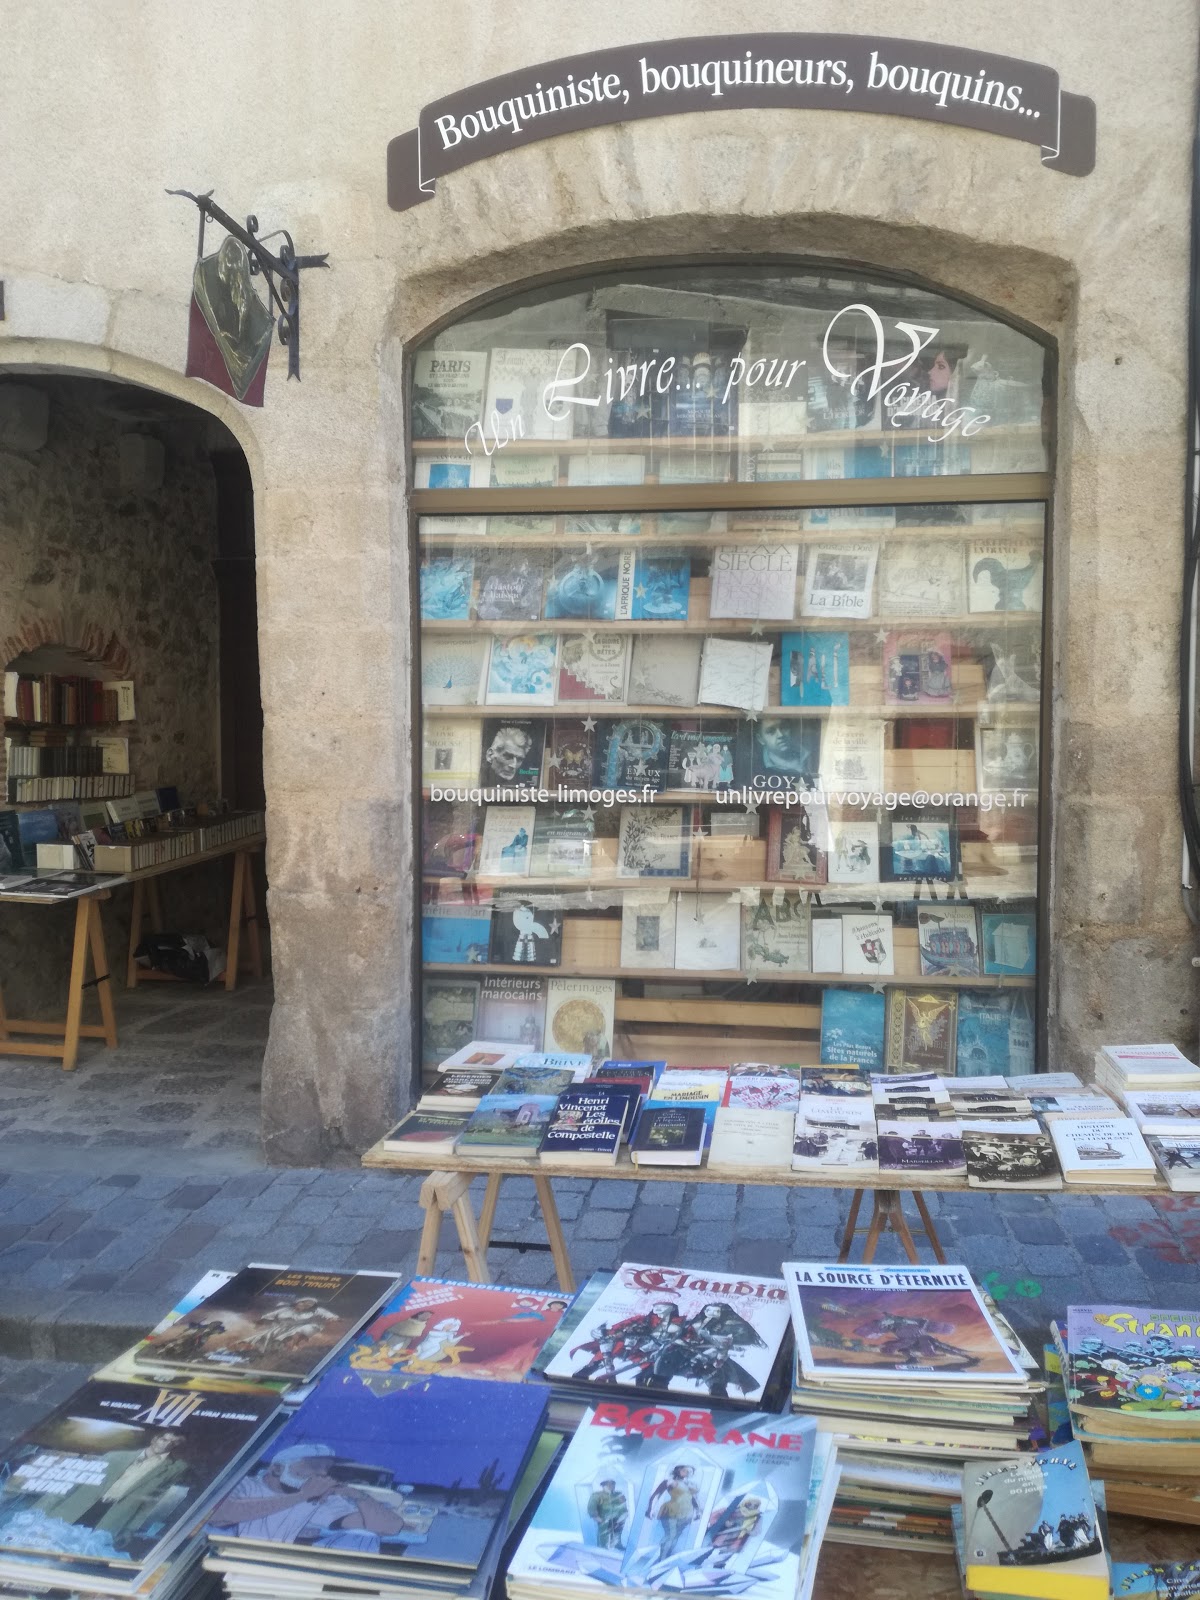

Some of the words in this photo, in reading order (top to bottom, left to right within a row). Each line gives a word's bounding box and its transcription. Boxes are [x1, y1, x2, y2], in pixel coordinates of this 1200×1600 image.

[434, 71, 630, 150] Bouquiniste,
[639, 51, 856, 96] bouquineurs,
[868, 52, 1042, 119] bouquins...
[429, 360, 471, 373] PARIS
[543, 343, 700, 421] Livre...
[722, 352, 806, 404] pour
[823, 304, 990, 442] Voyage
[622, 551, 632, 574] NOIRE
[718, 555, 792, 572] SIECLE
[810, 594, 828, 606] La
[832, 590, 864, 608] Bible
[430, 784, 657, 807] bouquiniste-limoges.fr
[716, 787, 1029, 811] unlivrepourvoyage@orange.fr
[484, 976, 541, 989] Intérieurs
[550, 980, 613, 994] Pèlerinages
[481, 990, 543, 1000] marocains
[849, 1056, 874, 1064] France
[559, 1104, 607, 1112] Vincenot
[578, 1097, 609, 1105] Henri
[583, 1117, 620, 1125] étoiles
[547, 1131, 616, 1140] Compostelle
[624, 1266, 787, 1298] Claudia
[795, 1271, 813, 1282] LA
[818, 1272, 875, 1285] SOURCE
[880, 1273, 968, 1286] D'ÉTERNITÉ
[420, 1277, 446, 1285] LES
[449, 1279, 501, 1291] MONDES
[503, 1286, 574, 1300] ENGLOUTIS
[590, 1402, 715, 1429] BOB
[626, 1421, 803, 1451] MORANE
[538, 1566, 577, 1575] LOMBARD
